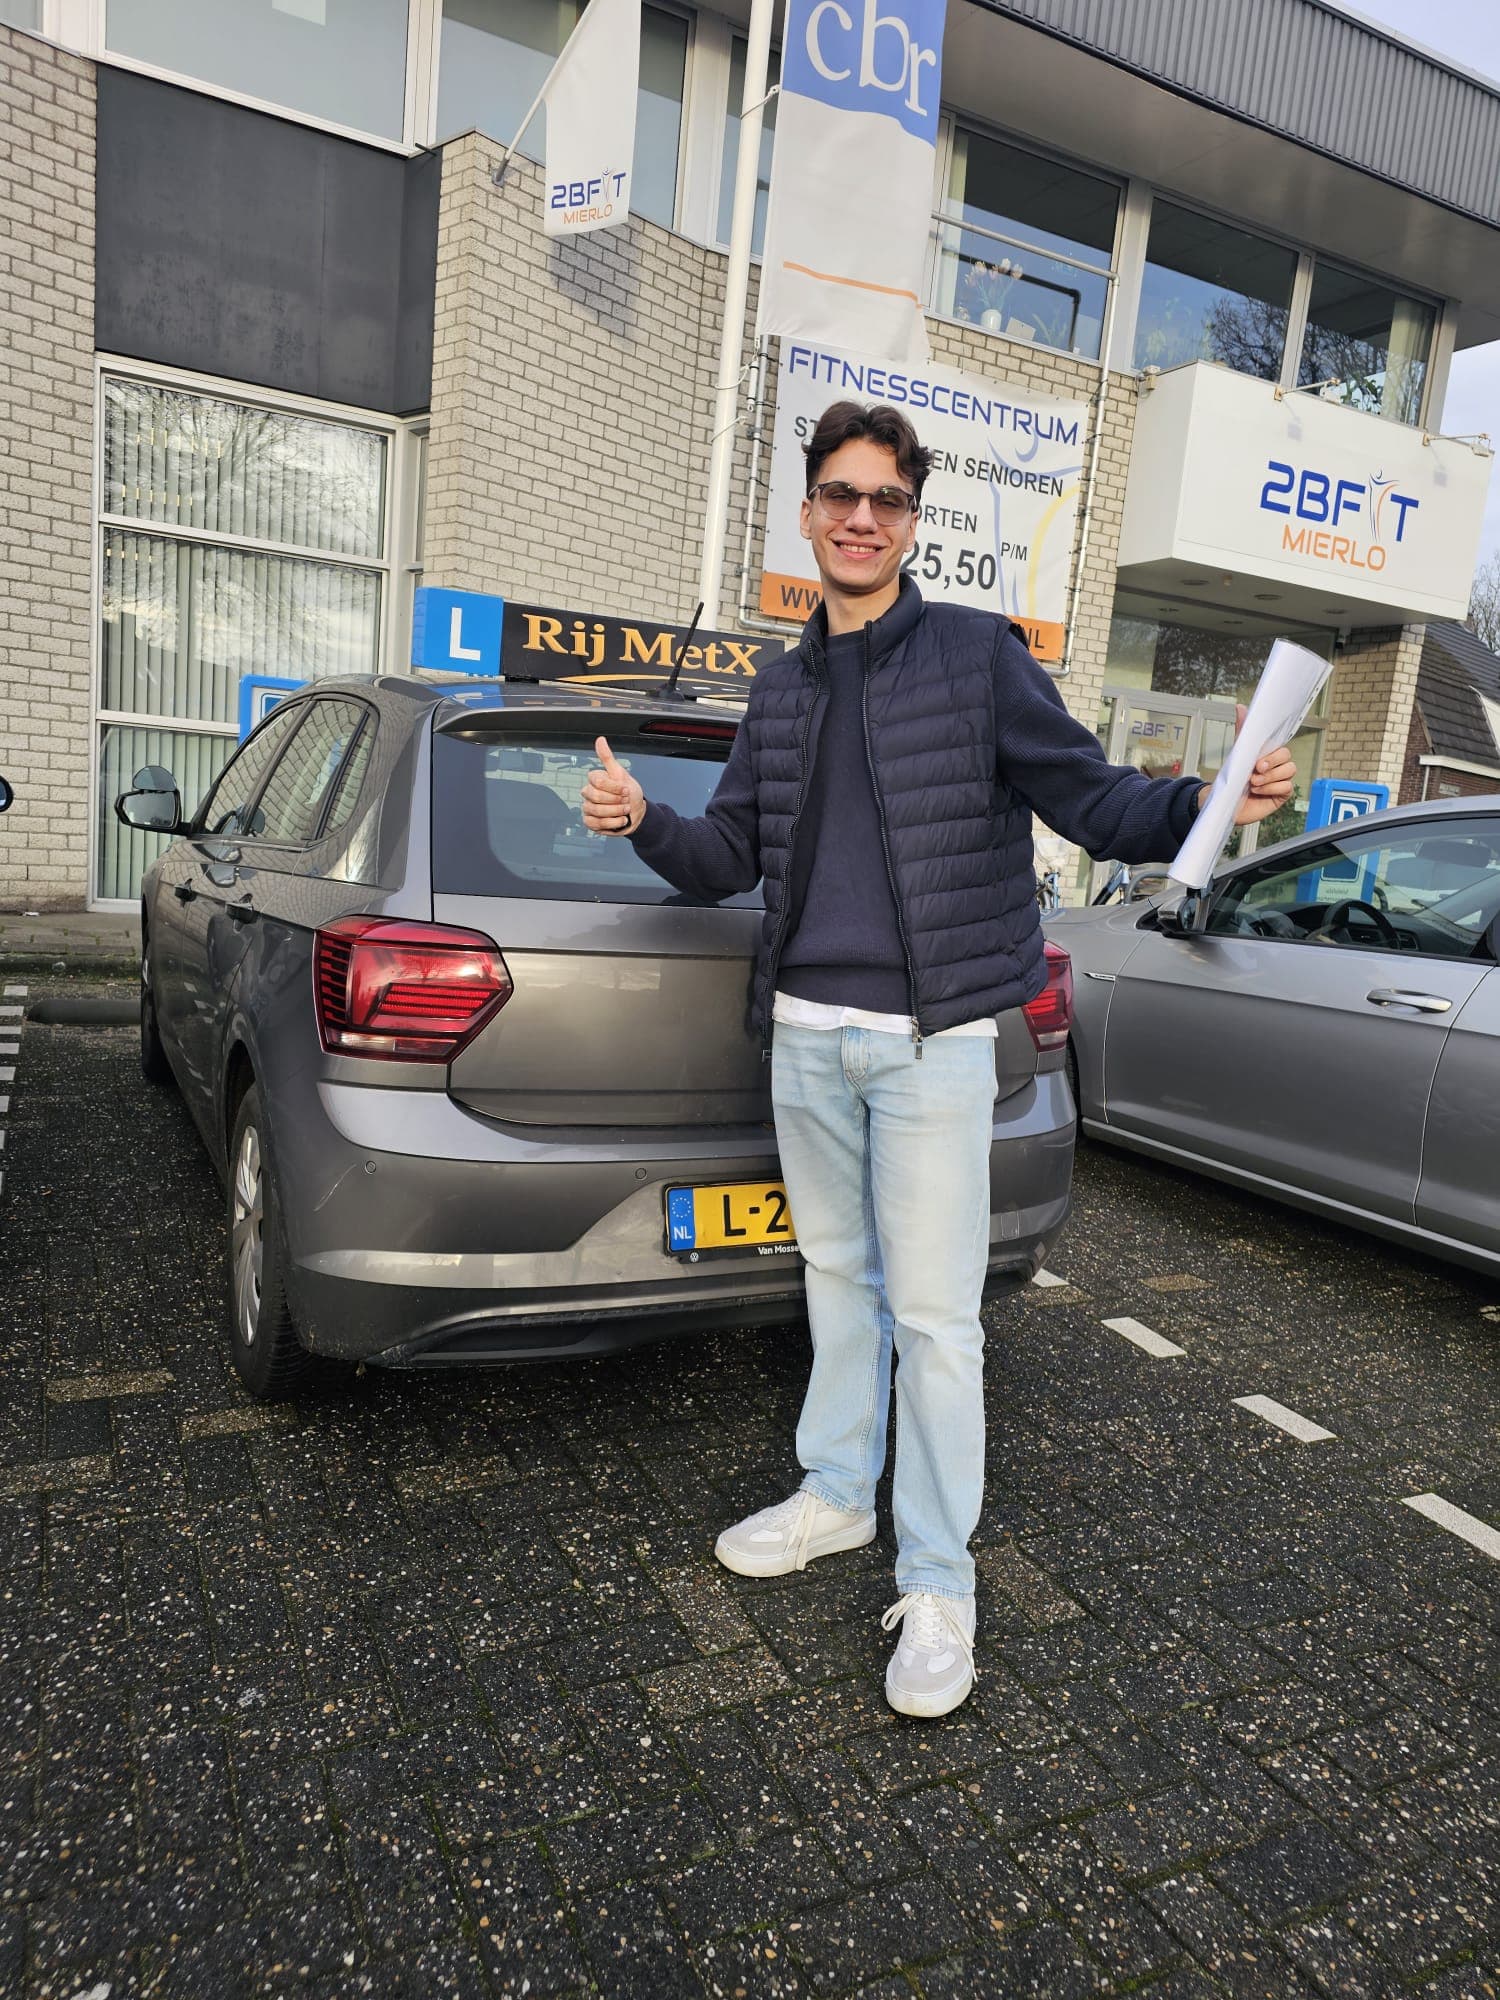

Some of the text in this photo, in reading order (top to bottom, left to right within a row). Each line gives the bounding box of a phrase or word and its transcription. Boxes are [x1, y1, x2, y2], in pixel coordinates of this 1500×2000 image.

[806, 0, 936, 116] cbr
[563, 204, 612, 224] MIERLO
[789, 346, 1079, 446] FITNESSCENTRUM
[963, 457, 1064, 497] SENIOREN
[1001, 542, 1028, 561] P/M
[1282, 524, 1386, 571] MIERLO
[449, 607, 481, 661] L
[521, 613, 762, 676] Rij MetX
[673, 1226, 692, 1240] NL
[757, 1246, 773, 1255] Van
